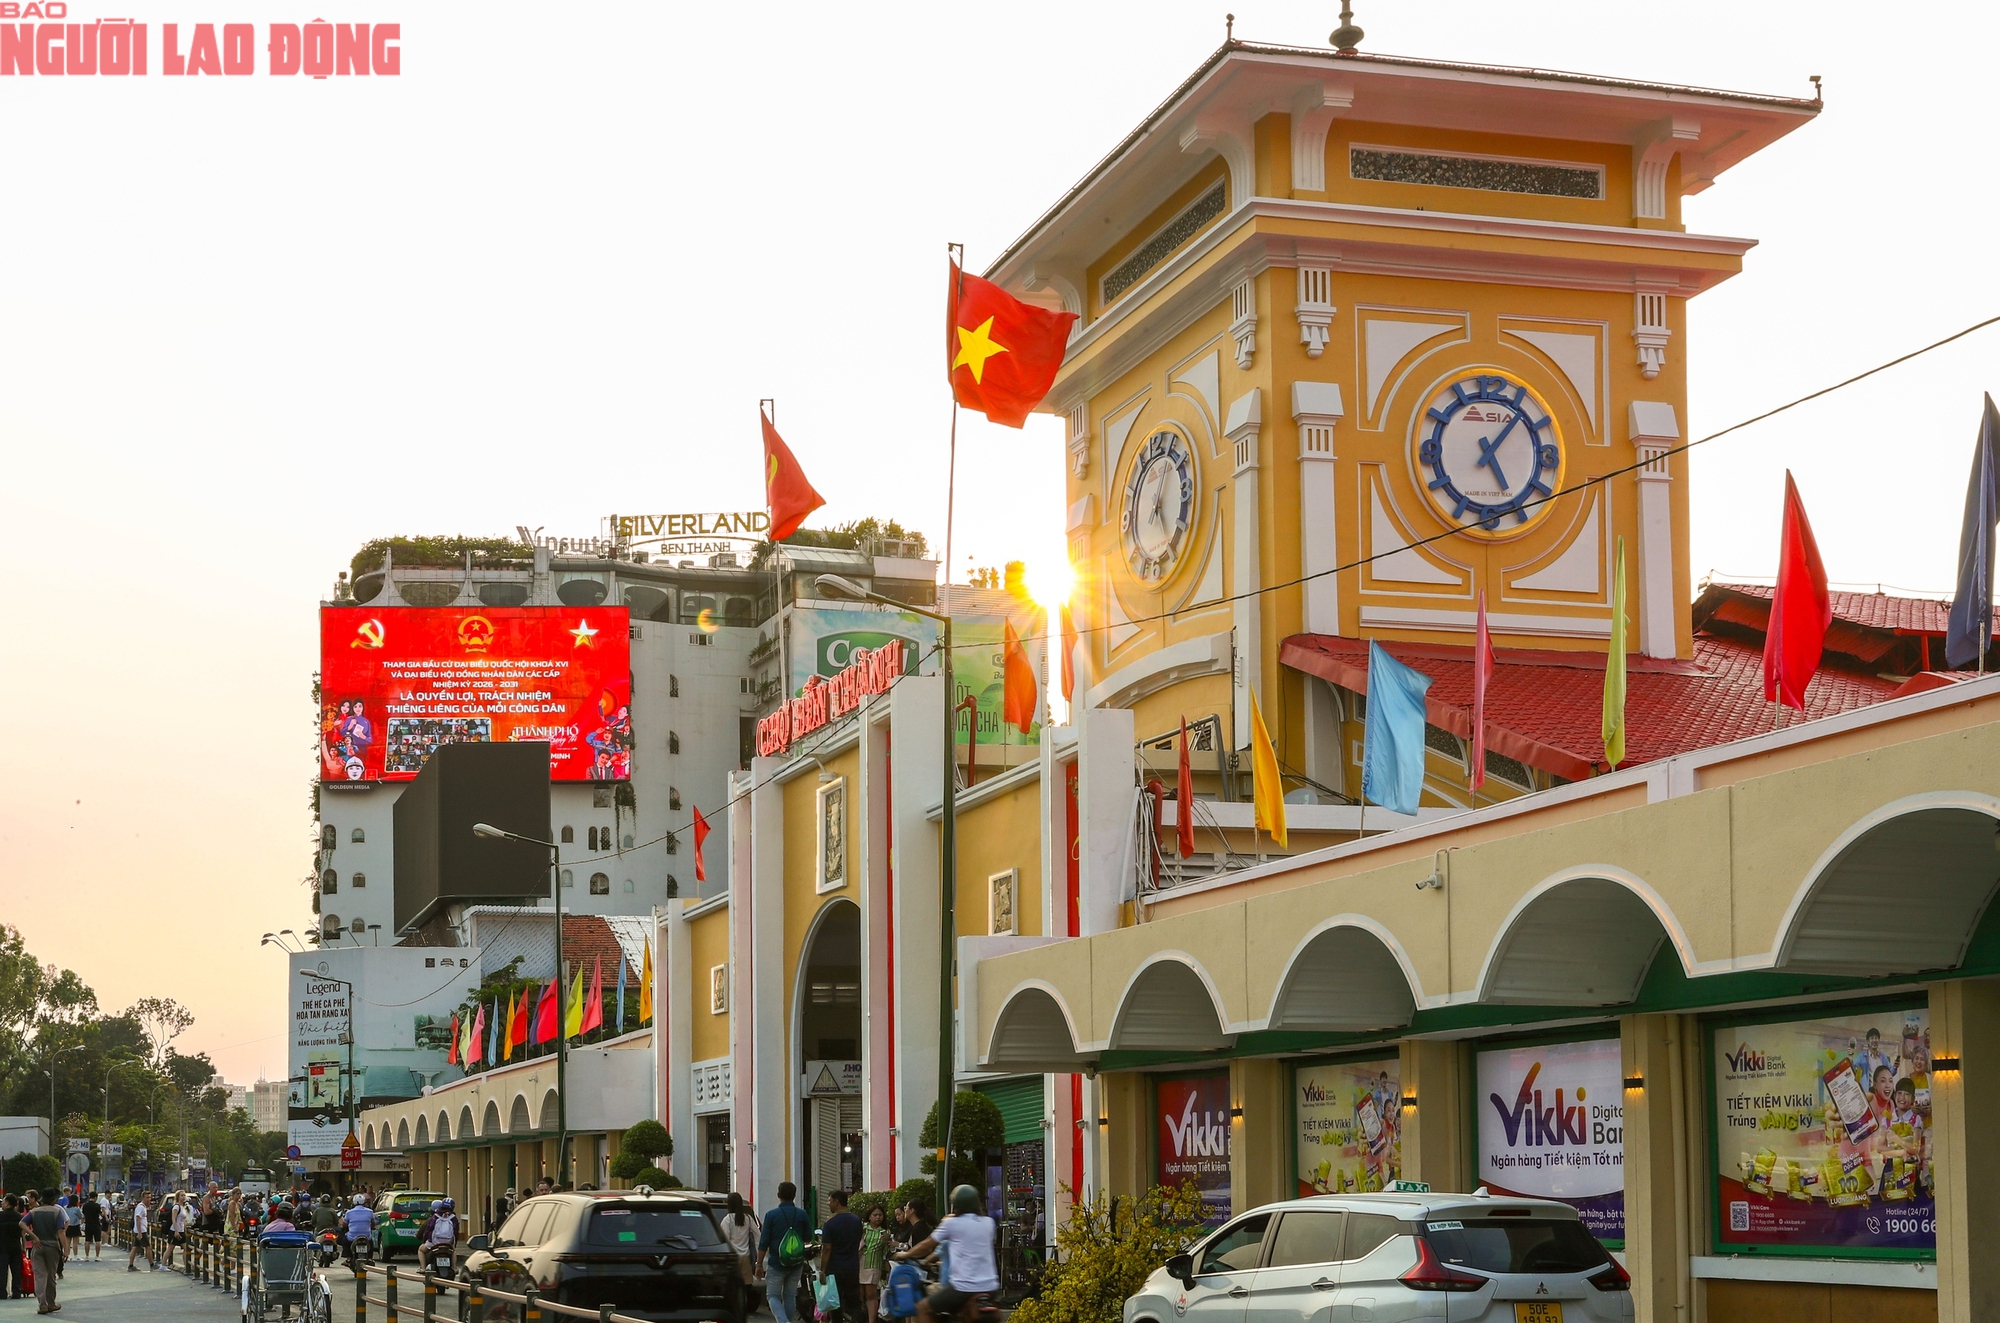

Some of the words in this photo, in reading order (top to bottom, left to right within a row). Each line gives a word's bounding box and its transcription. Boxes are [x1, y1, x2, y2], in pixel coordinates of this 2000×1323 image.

[1476, 375, 1508, 399] 12
[1149, 432, 1163, 458] 12
[1420, 438, 1442, 464] 9
[1540, 444, 1559, 468] 3
[1180, 477, 1192, 503] 3
[620, 511, 770, 536] SILVERLAND
[1121, 510, 1131, 533] 9
[1480, 505, 1500, 530] 6
[661, 543, 686, 554] BEN
[688, 542, 730, 554] THANH
[1151, 557, 1162, 580] 6
[454, 661, 468, 669] ĐẠI
[516, 660, 530, 668] HỘI
[391, 670, 402, 678] VÀ
[404, 671, 418, 679] ĐẠI
[440, 670, 454, 678] HỘI
[482, 670, 505, 678] NHÂN
[506, 670, 524, 678] DÂN
[526, 670, 542, 678] CÁC
[400, 691, 414, 700] LÀ
[478, 690, 512, 700] TRÁCH
[516, 691, 551, 702] NHIỆM
[386, 703, 426, 713] THIÊNG
[428, 703, 460, 713] LIÊNG
[508, 703, 540, 713] CÔNG
[542, 703, 566, 713] DÂN
[756, 699, 792, 757] CHỢ
[306, 982, 340, 996] Legend
[310, 1010, 320, 1019] TAN
[322, 1008, 338, 1018] RANG
[1725, 1042, 1765, 1072] Vikki
[1767, 1061, 1786, 1070] Bank
[1302, 1079, 1325, 1102] Vikki
[1490, 1062, 1587, 1147] Vikki
[1727, 1092, 1750, 1110] TIẾT
[1754, 1092, 1781, 1112] KIỆM
[1784, 1094, 1812, 1107] Vikki
[1165, 1090, 1224, 1157] Vikki
[1303, 1117, 1316, 1130] TIẾT
[1318, 1118, 1334, 1130] KIỆM
[1335, 1118, 1351, 1128] Vikki
[1727, 1114, 1756, 1128] Trúng
[1800, 1113, 1812, 1128] ký
[1303, 1132, 1320, 1144] Trúng
[1166, 1162, 1181, 1174] Ngân
[1182, 1162, 1197, 1174] hàng
[1198, 1160, 1210, 1172] Tiết
[1212, 1160, 1227, 1174] kiệm
[1491, 1154, 1516, 1169] Ngân
[1518, 1152, 1542, 1169] hàng
[1544, 1150, 1564, 1166] Tiết
[1566, 1152, 1590, 1170] kiệm
[1592, 1150, 1610, 1165] Tốt
[1398, 1182, 1428, 1192] TAXI
[1908, 1208, 1929, 1216] (24/7)
[1886, 1218, 1918, 1232] 1900
[1529, 1304, 1548, 1314] 50E
